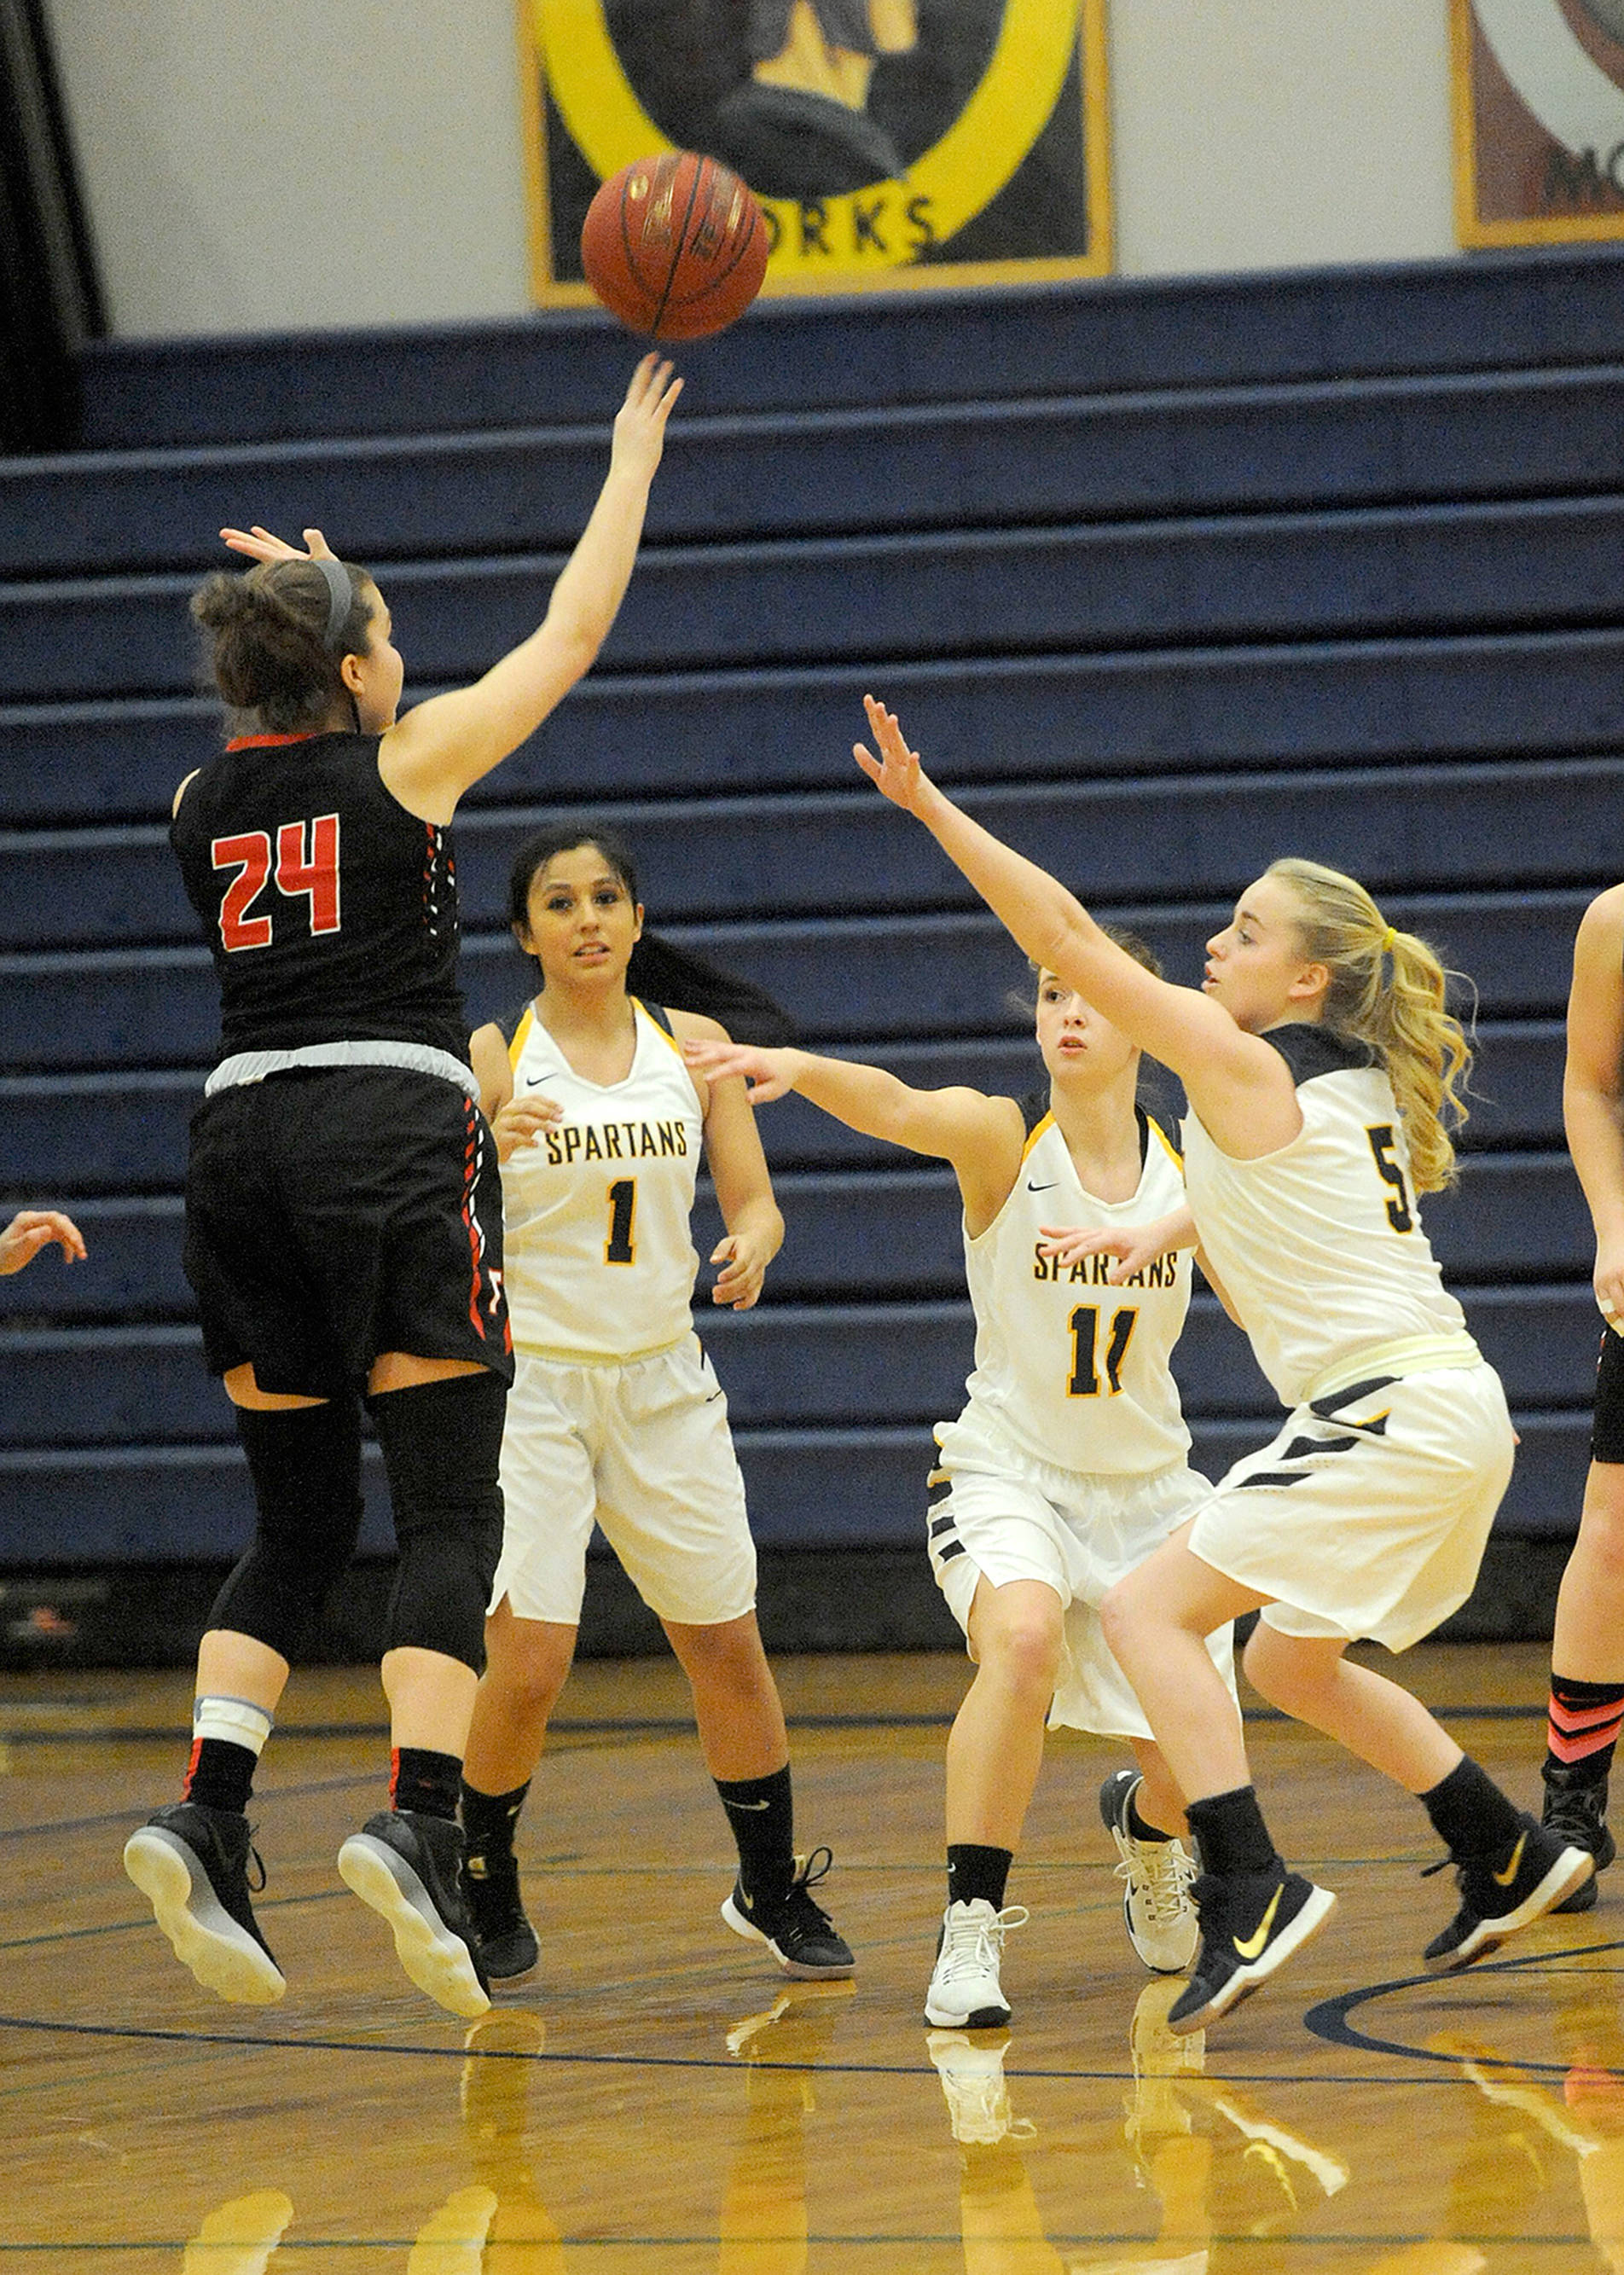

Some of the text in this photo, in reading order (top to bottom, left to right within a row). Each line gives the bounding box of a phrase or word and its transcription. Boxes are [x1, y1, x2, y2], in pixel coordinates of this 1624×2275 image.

[212, 813, 341, 953] 24
[544, 1120, 687, 1166] SPARTANS
[1365, 1122, 1413, 1234] 5
[603, 1175, 638, 1267] 1
[1033, 1242, 1178, 1288] SARANS
[1066, 1303, 1140, 1398] 11
